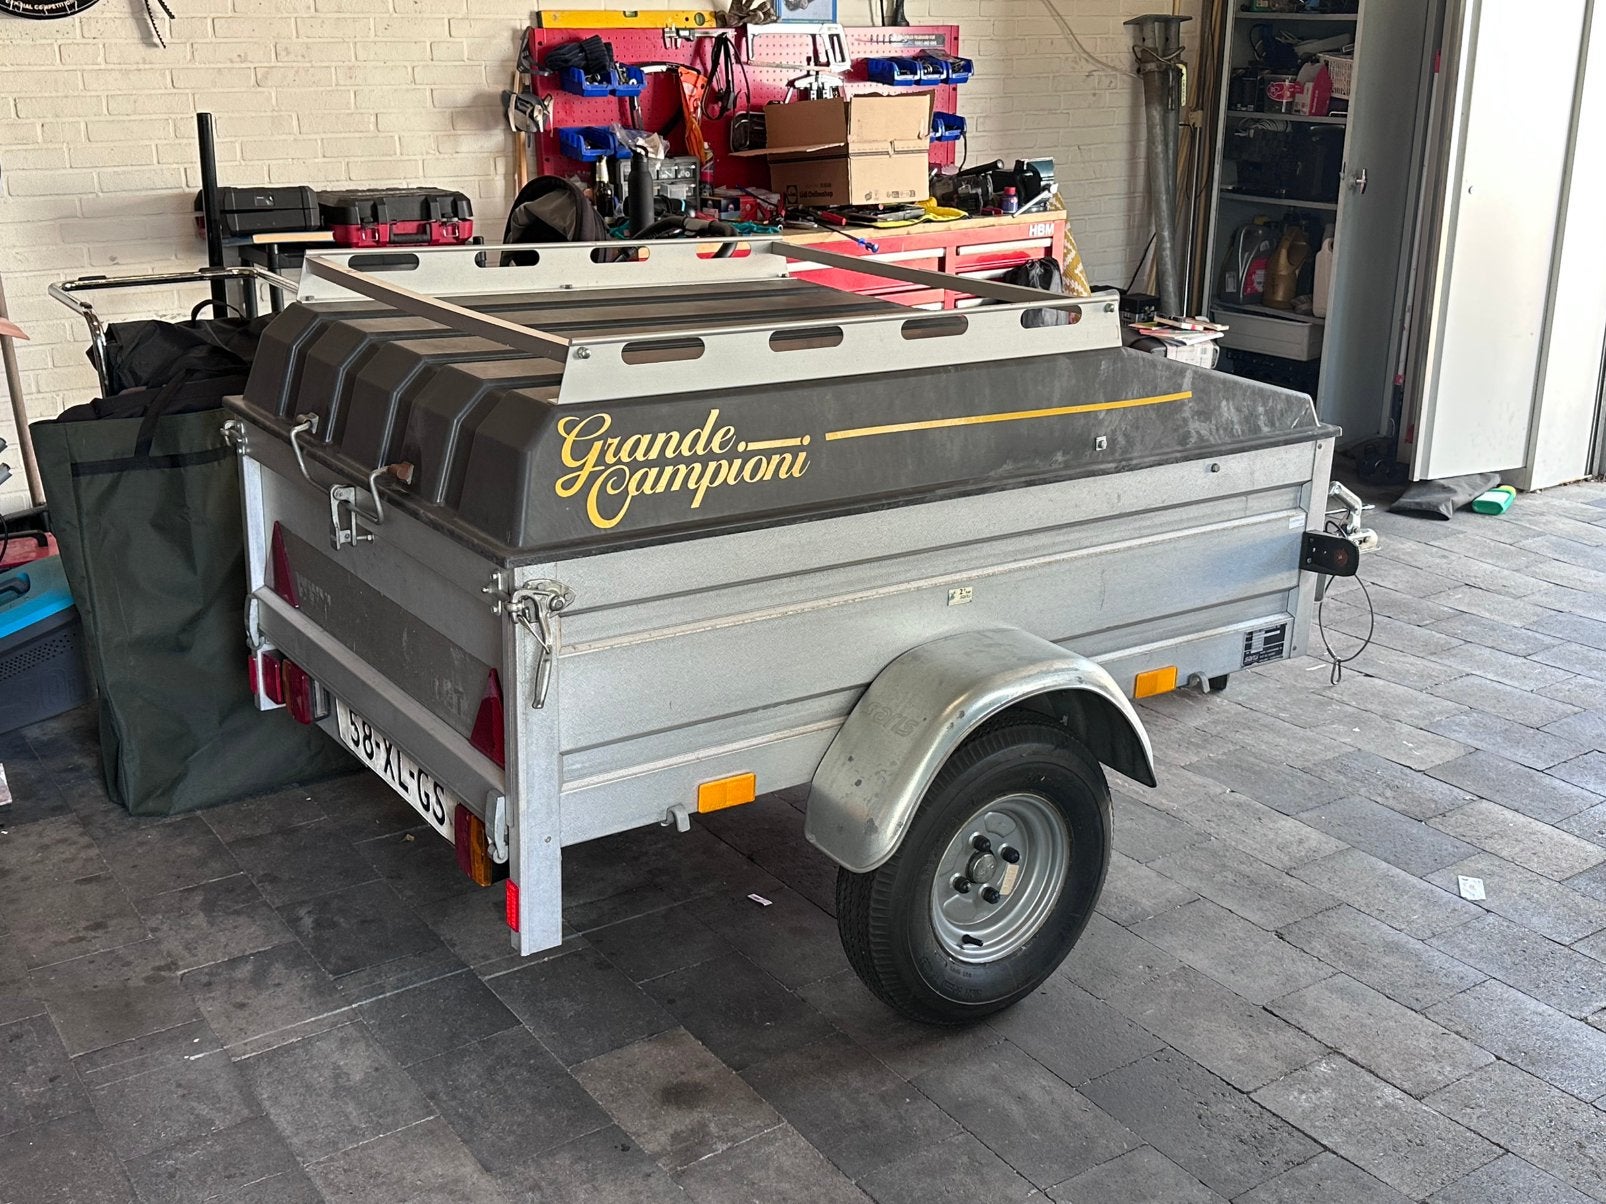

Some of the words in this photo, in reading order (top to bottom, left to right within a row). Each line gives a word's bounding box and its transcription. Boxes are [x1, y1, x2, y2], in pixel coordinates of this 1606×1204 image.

[1029, 222, 1054, 237] HBM
[555, 408, 736, 498] Grande
[587, 435, 811, 529] Campioni
[348, 709, 446, 827] 58-XL-GS
